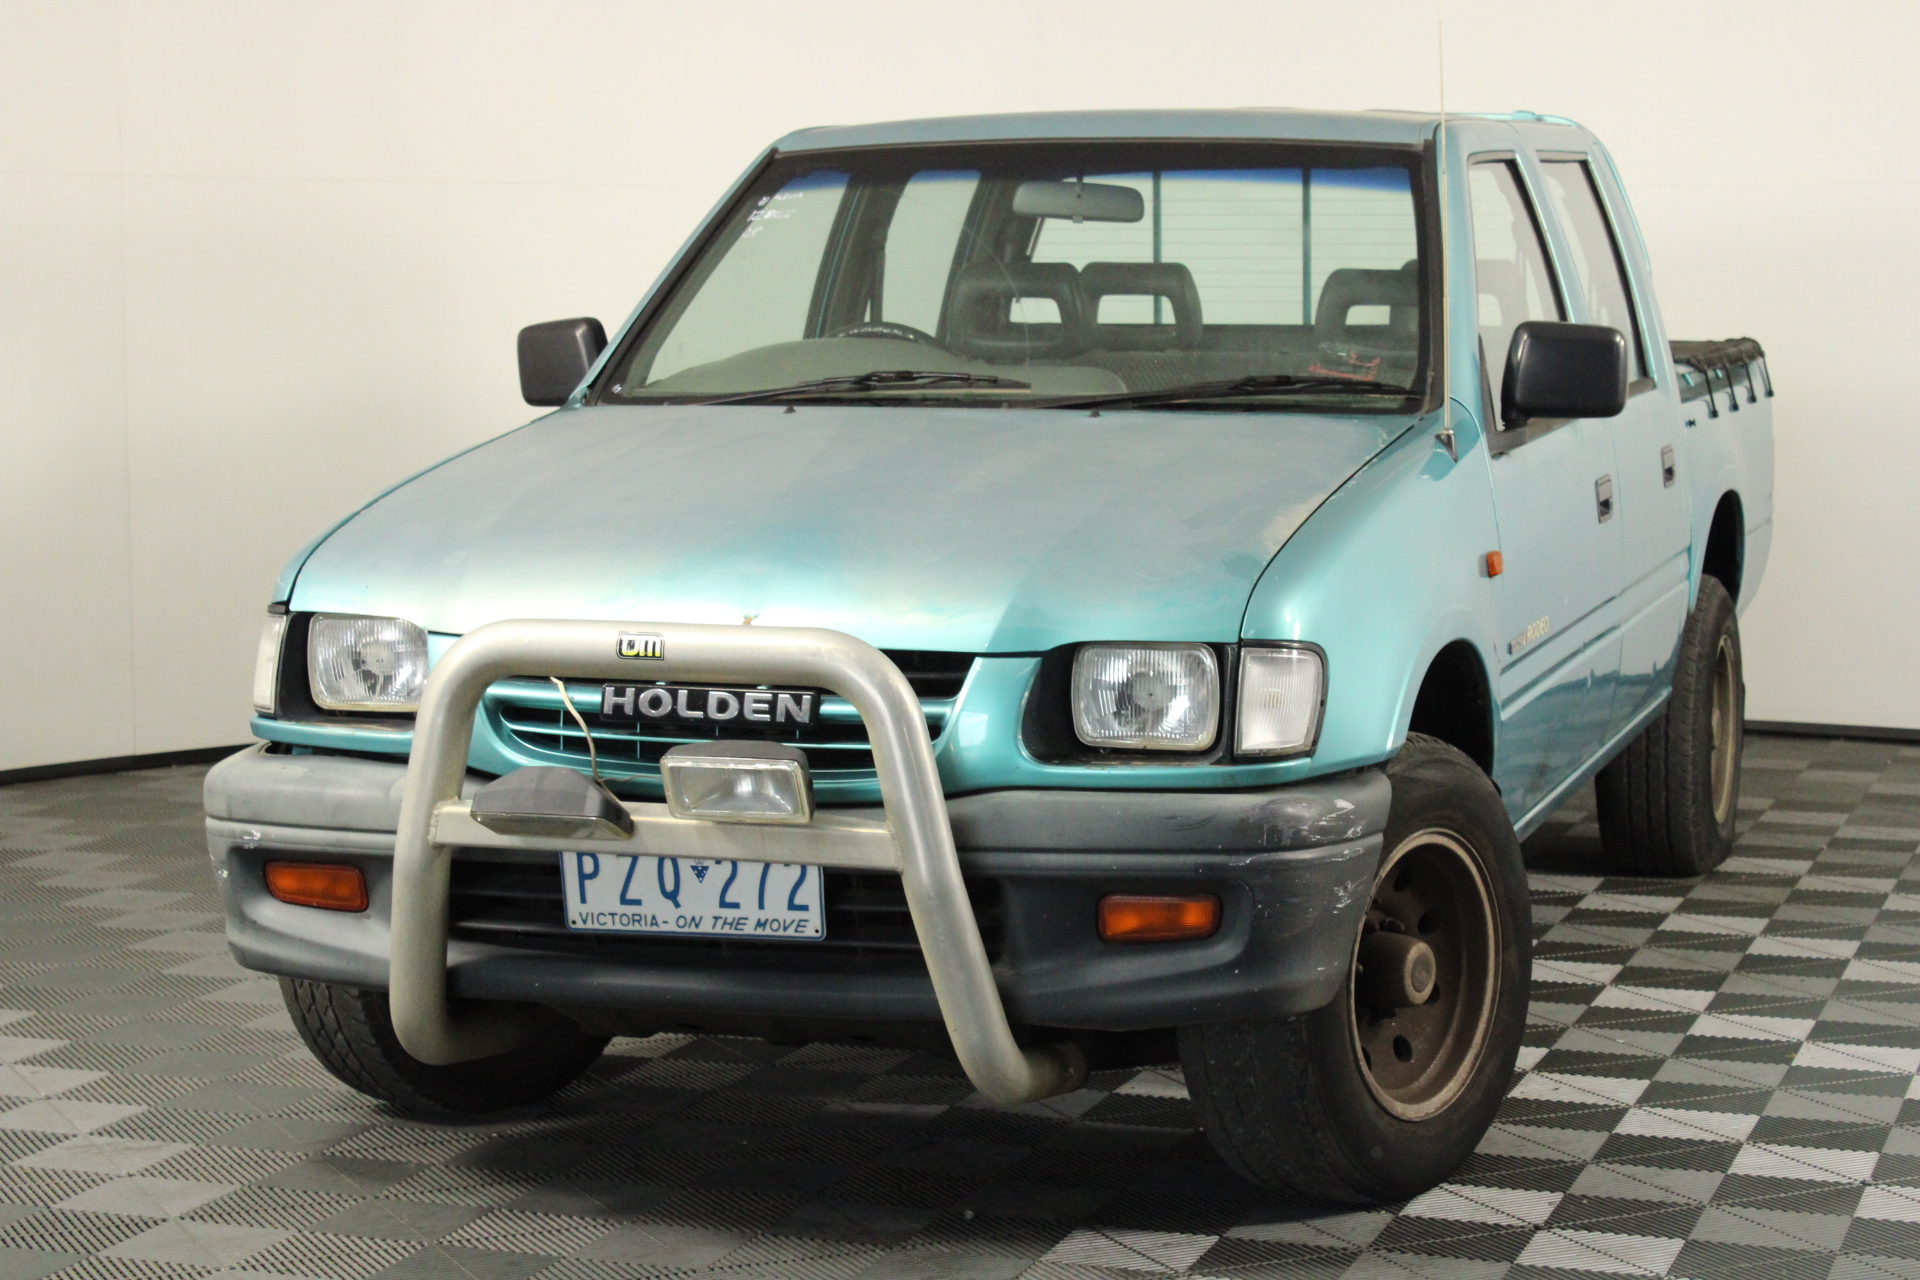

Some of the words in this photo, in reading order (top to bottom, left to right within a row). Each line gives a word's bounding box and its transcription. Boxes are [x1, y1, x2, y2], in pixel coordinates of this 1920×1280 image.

[603, 686, 812, 723] HOLDEN
[576, 852, 682, 909] PZQ
[675, 915, 702, 930] ON
[712, 916, 749, 932] THE
[754, 918, 810, 934] MOVE
